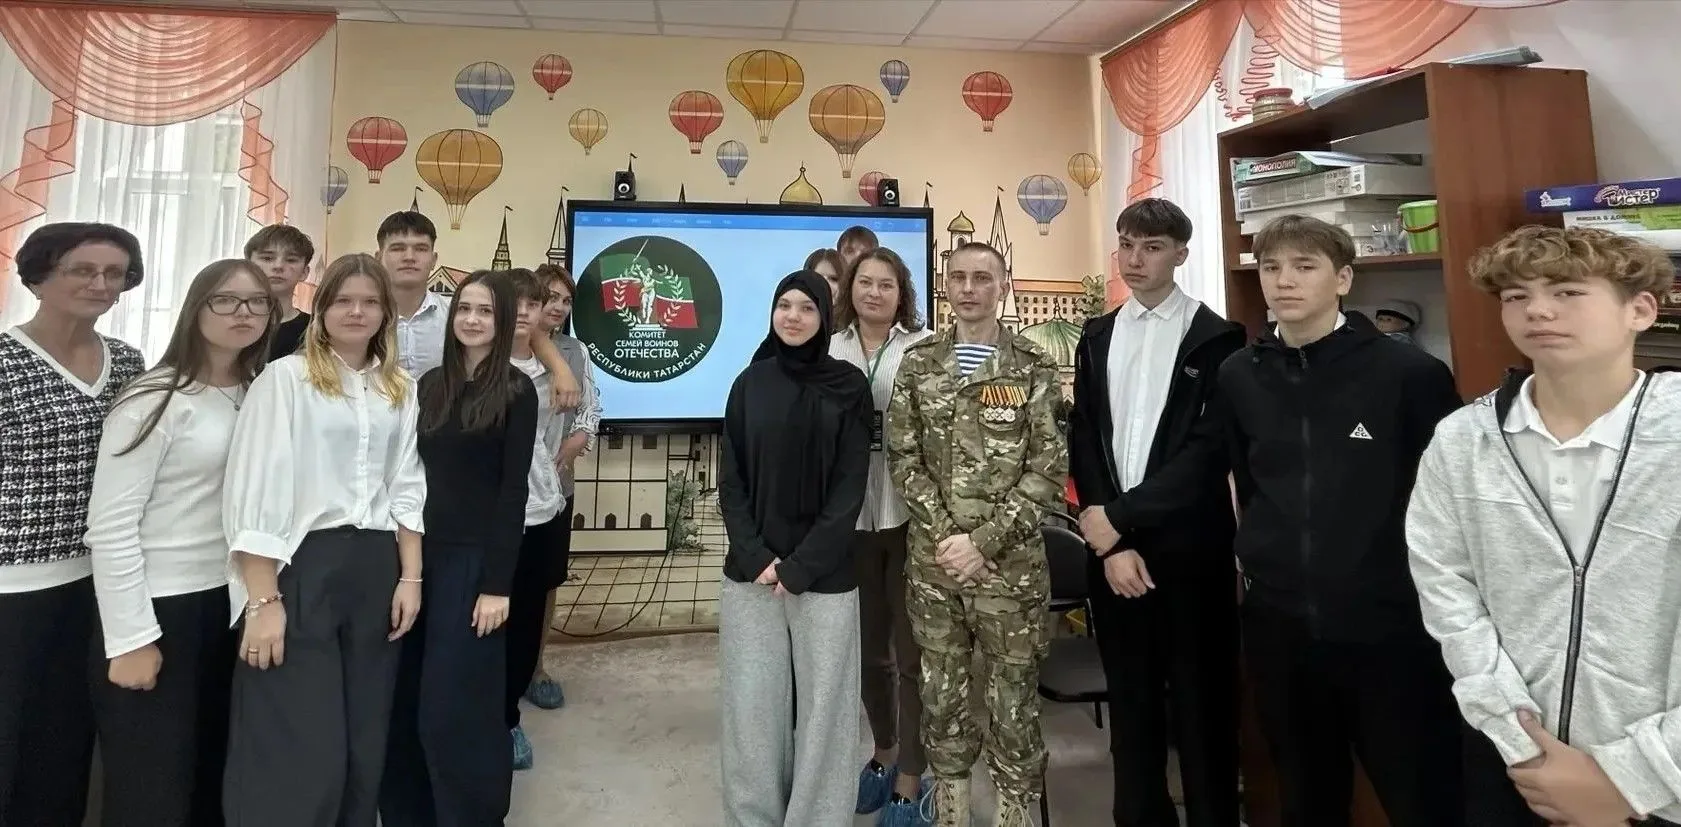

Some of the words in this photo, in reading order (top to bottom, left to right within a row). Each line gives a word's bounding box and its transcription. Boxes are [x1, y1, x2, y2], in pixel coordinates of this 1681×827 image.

[629, 331, 666, 339] КОМИТЕТ
[615, 339, 643, 347] СЕМЕЙ
[614, 348, 680, 358] ОТЕЧЕСТВА
[588, 342, 650, 379] РЕСПУБЛИКИ
[653, 342, 706, 378] ТАТАРСТАН
